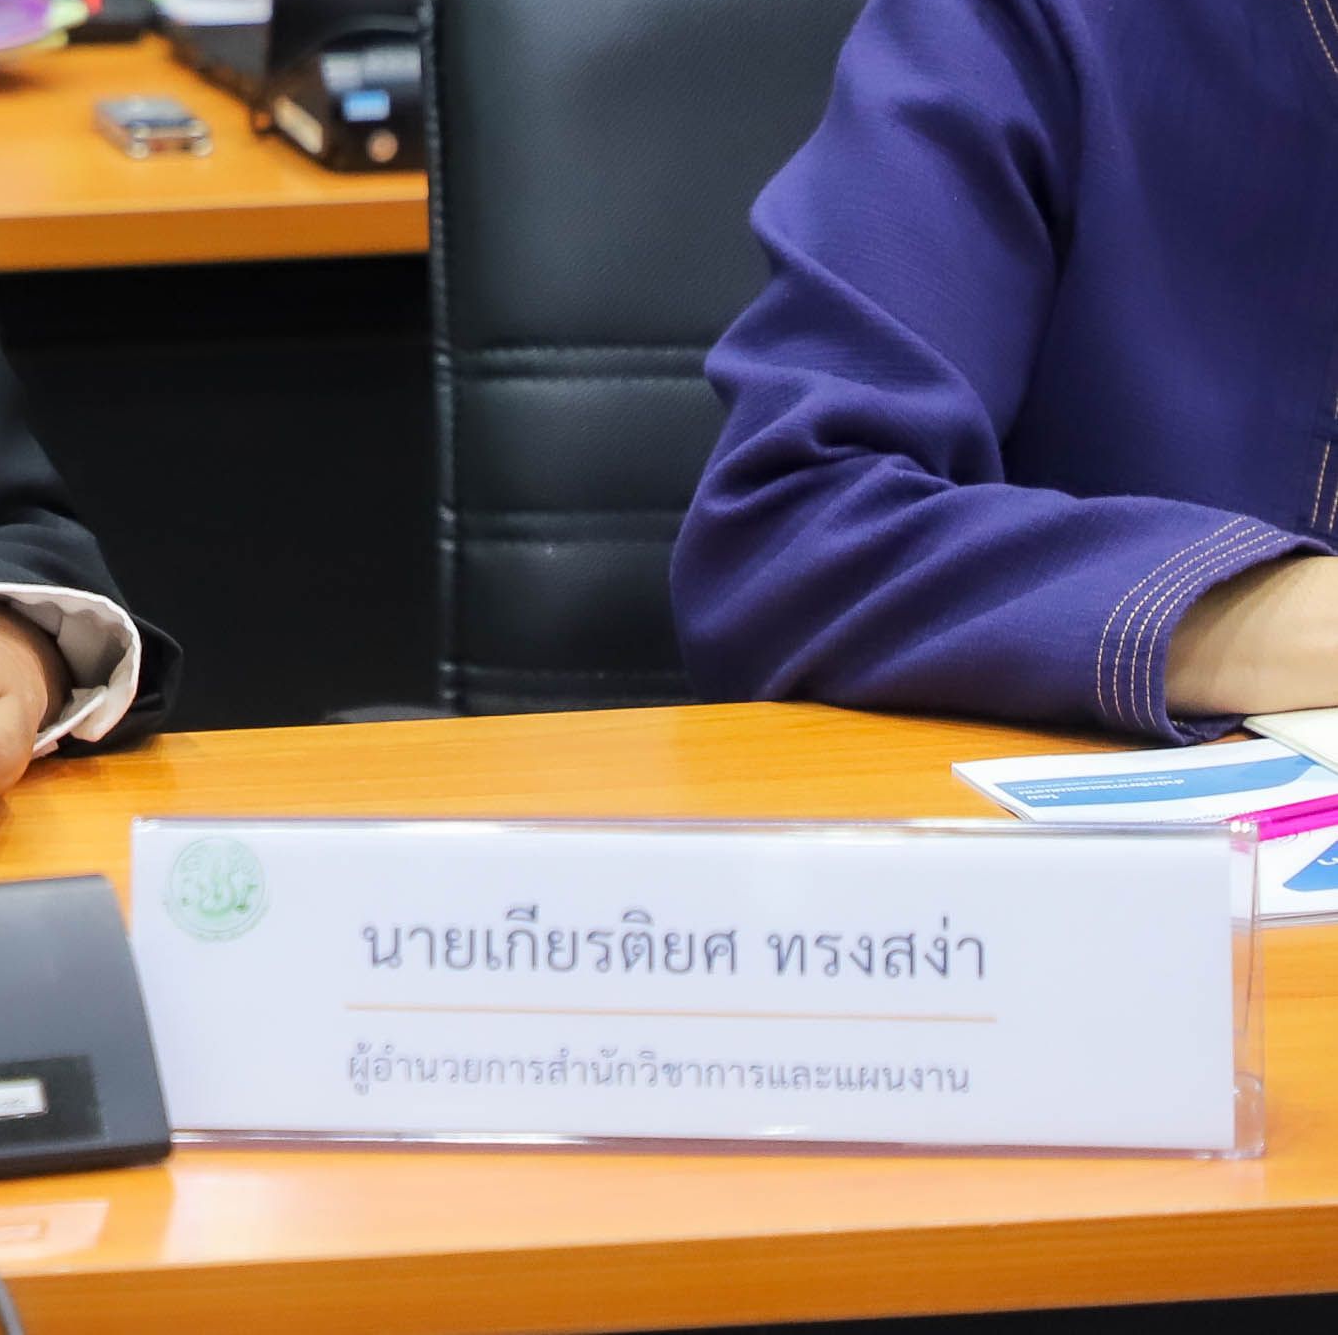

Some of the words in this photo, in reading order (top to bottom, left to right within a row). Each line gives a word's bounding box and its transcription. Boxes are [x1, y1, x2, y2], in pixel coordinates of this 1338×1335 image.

[362, 904, 738, 976] นายเกียรติยศ
[766, 914, 986, 979] ทรงสง่า
[347, 1040, 972, 1096] ผู้อำนวยการสำนักวิชาการและแผนงาน
